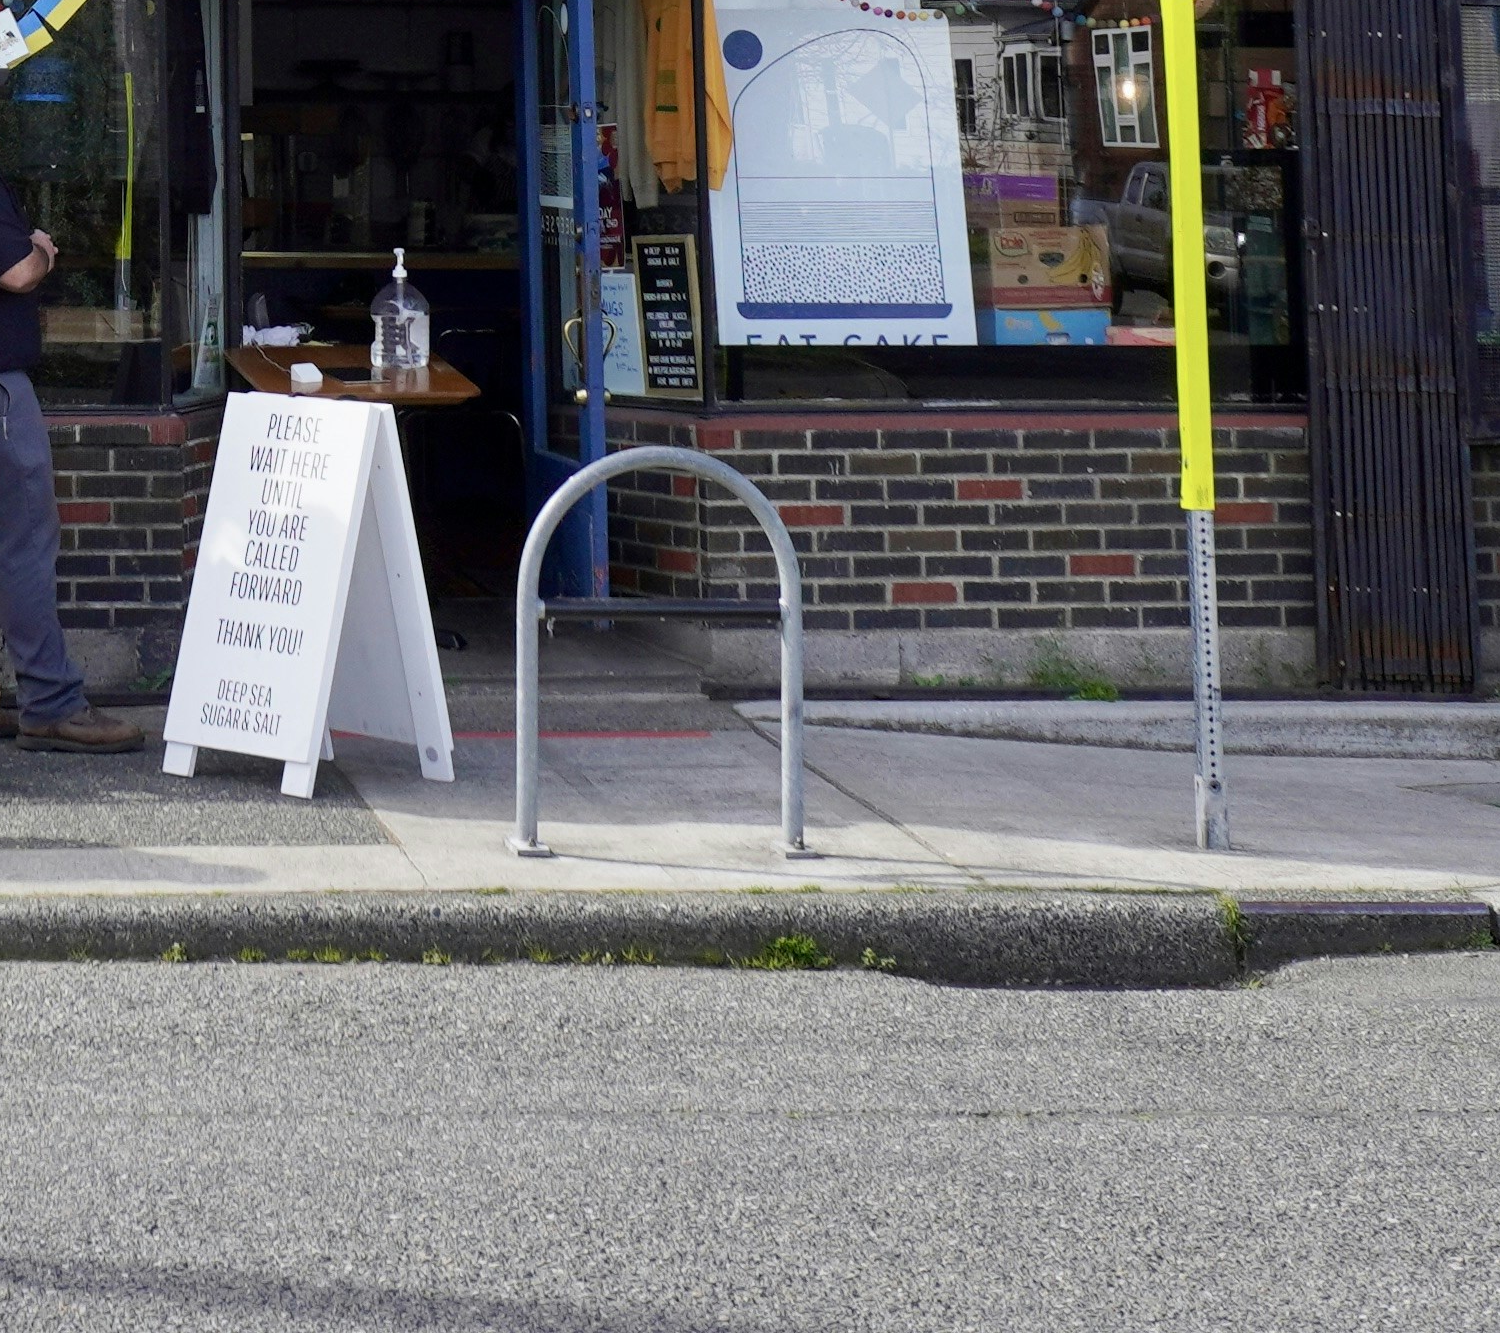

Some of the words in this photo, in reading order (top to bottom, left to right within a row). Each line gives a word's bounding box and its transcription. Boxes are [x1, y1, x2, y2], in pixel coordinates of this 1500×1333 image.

[267, 413, 323, 444] PLEASE
[250, 444, 288, 475] WAIT
[289, 449, 331, 481] HERE
[261, 478, 303, 509] UNTIL
[249, 509, 277, 538] YOU
[278, 514, 310, 542] ARE
[244, 539, 300, 573] CALLED
[229, 571, 302, 606] FORWARD
[216, 618, 266, 650] THANK
[269, 625, 304, 656] YOU!
[217, 679, 248, 703] DEEP
[249, 683, 272, 708] SEA
[200, 702, 241, 730] SUGAR
[241, 709, 250, 732] &
[252, 711, 282, 736] SALT
